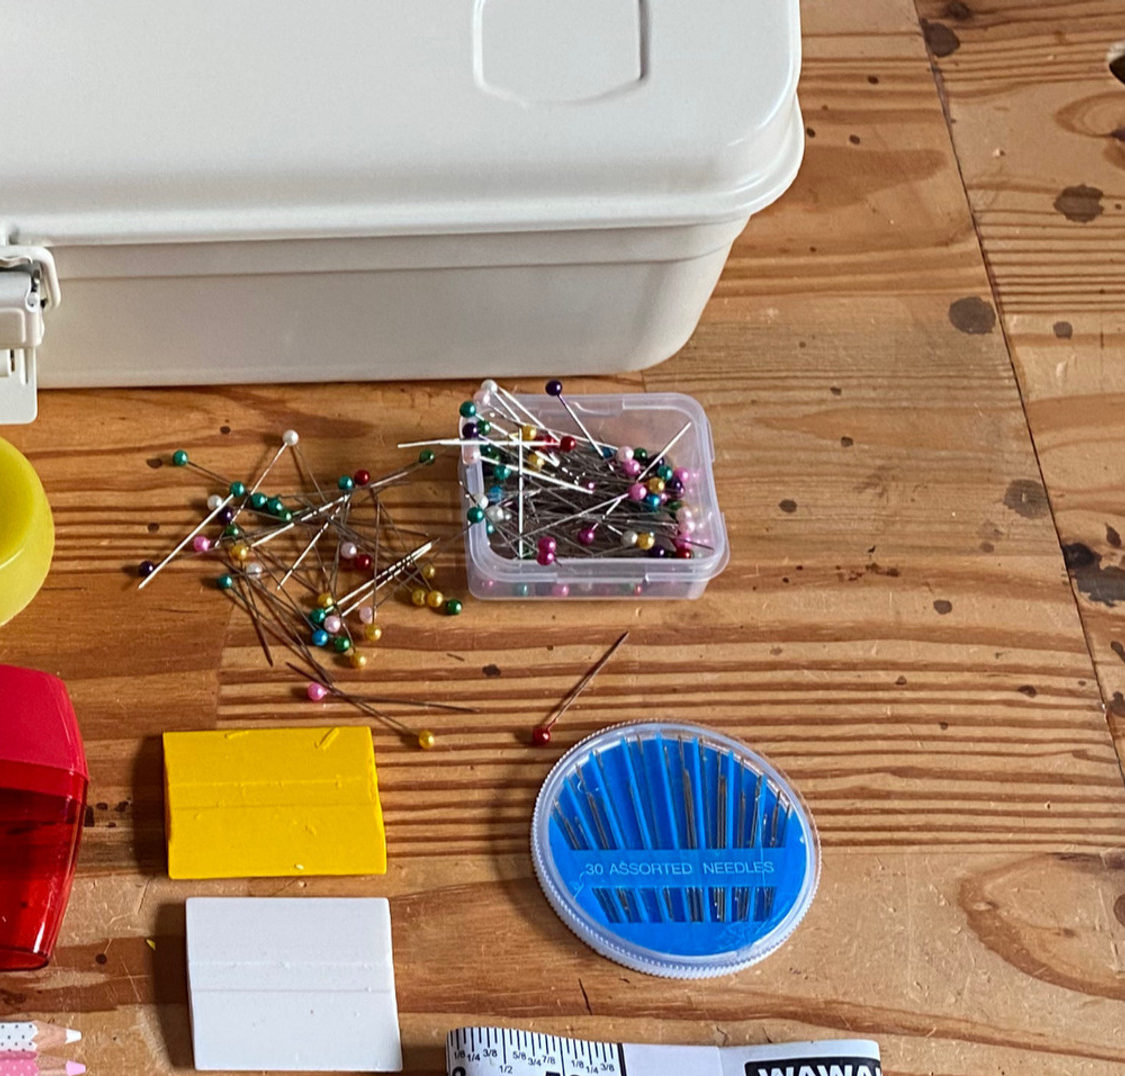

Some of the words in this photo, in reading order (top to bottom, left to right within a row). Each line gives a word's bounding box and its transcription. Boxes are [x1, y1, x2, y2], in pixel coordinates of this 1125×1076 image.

[586, 863, 603, 876] 30
[609, 861, 692, 875] ASSORTED
[703, 861, 774, 874] NEEDLES
[467, 1052, 481, 1062] 1/4
[483, 1048, 498, 1058] 3/8
[499, 1065, 513, 1075] 1/2
[513, 1050, 527, 1061] 5/8
[528, 1056, 542, 1067] 3/4
[542, 1055, 556, 1065] 7/8
[571, 1059, 584, 1069] 1/8
[586, 1065, 599, 1075] 1/4
[600, 1063, 615, 1073] 3/8
